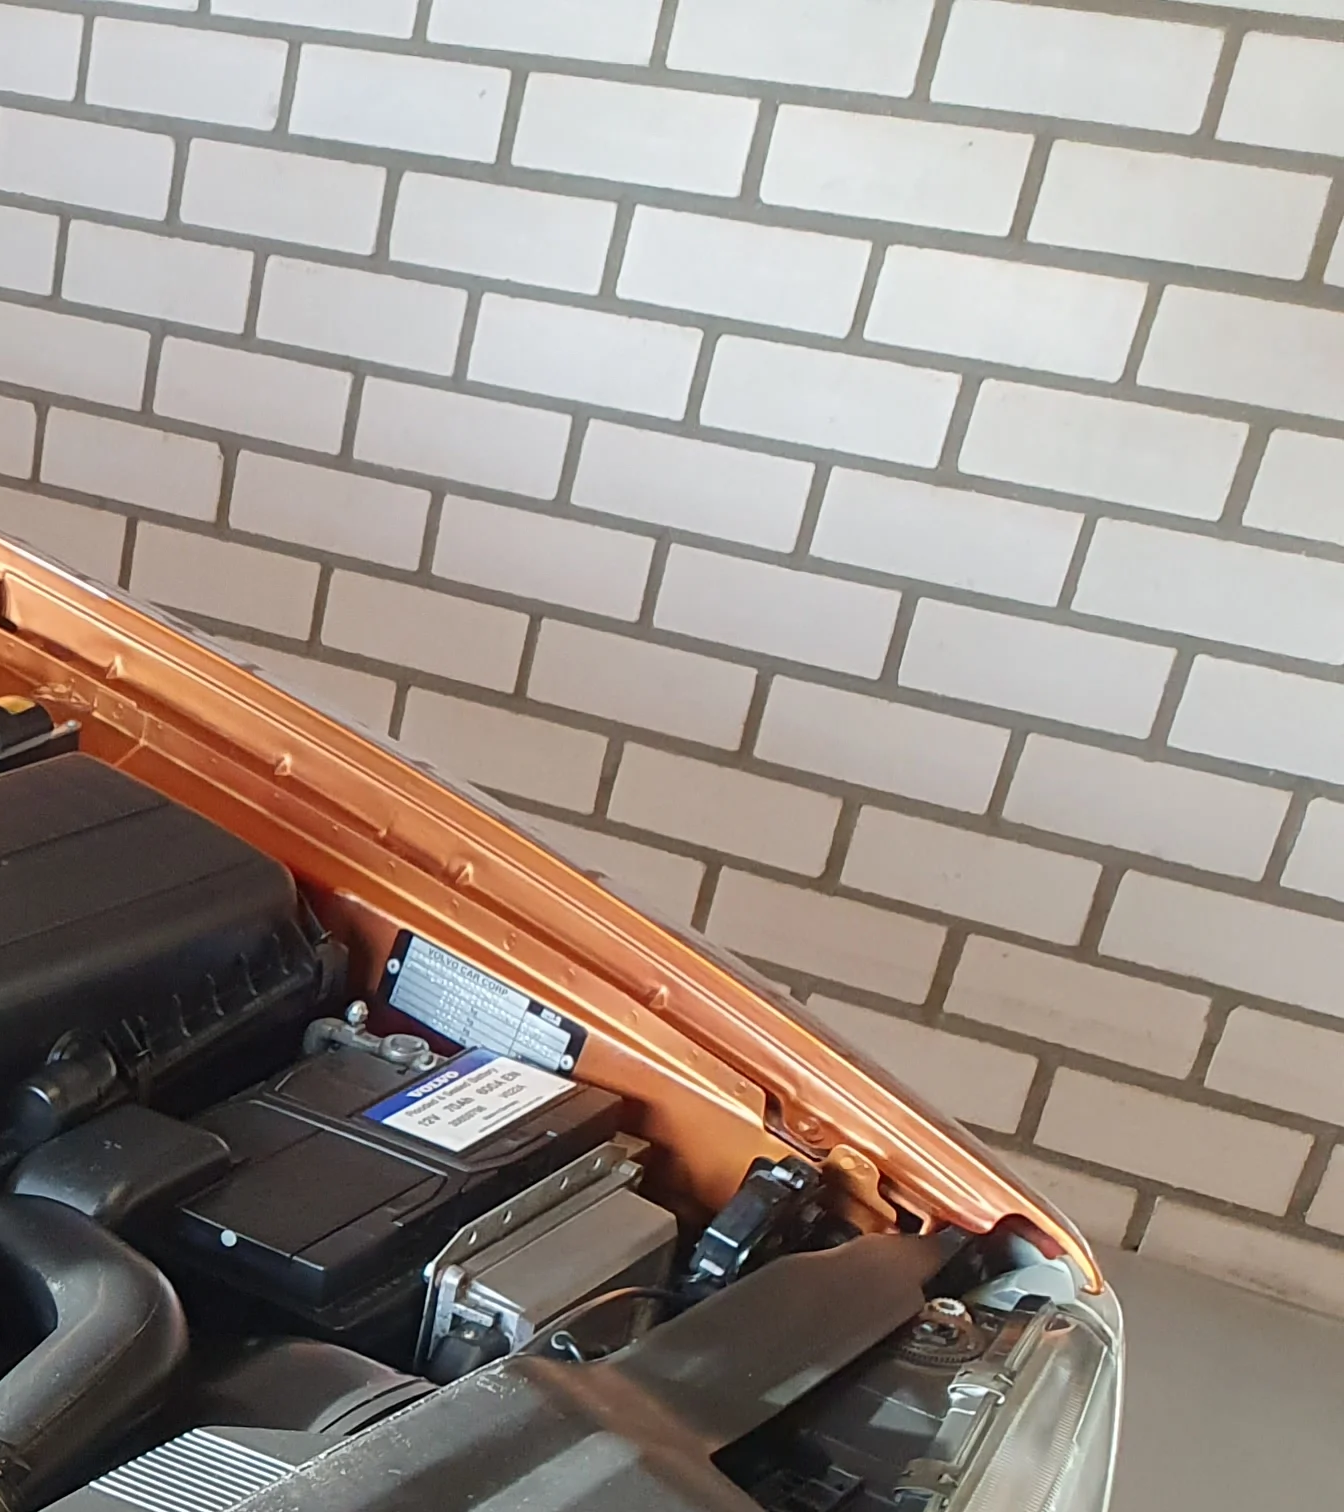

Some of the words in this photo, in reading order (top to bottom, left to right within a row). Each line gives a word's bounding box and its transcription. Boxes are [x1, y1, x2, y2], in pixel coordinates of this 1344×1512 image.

[428, 947, 459, 971] VOLVO
[461, 965, 482, 983] CAR
[406, 1071, 459, 1097] VOLVO
[418, 1112, 441, 1127] 12V
